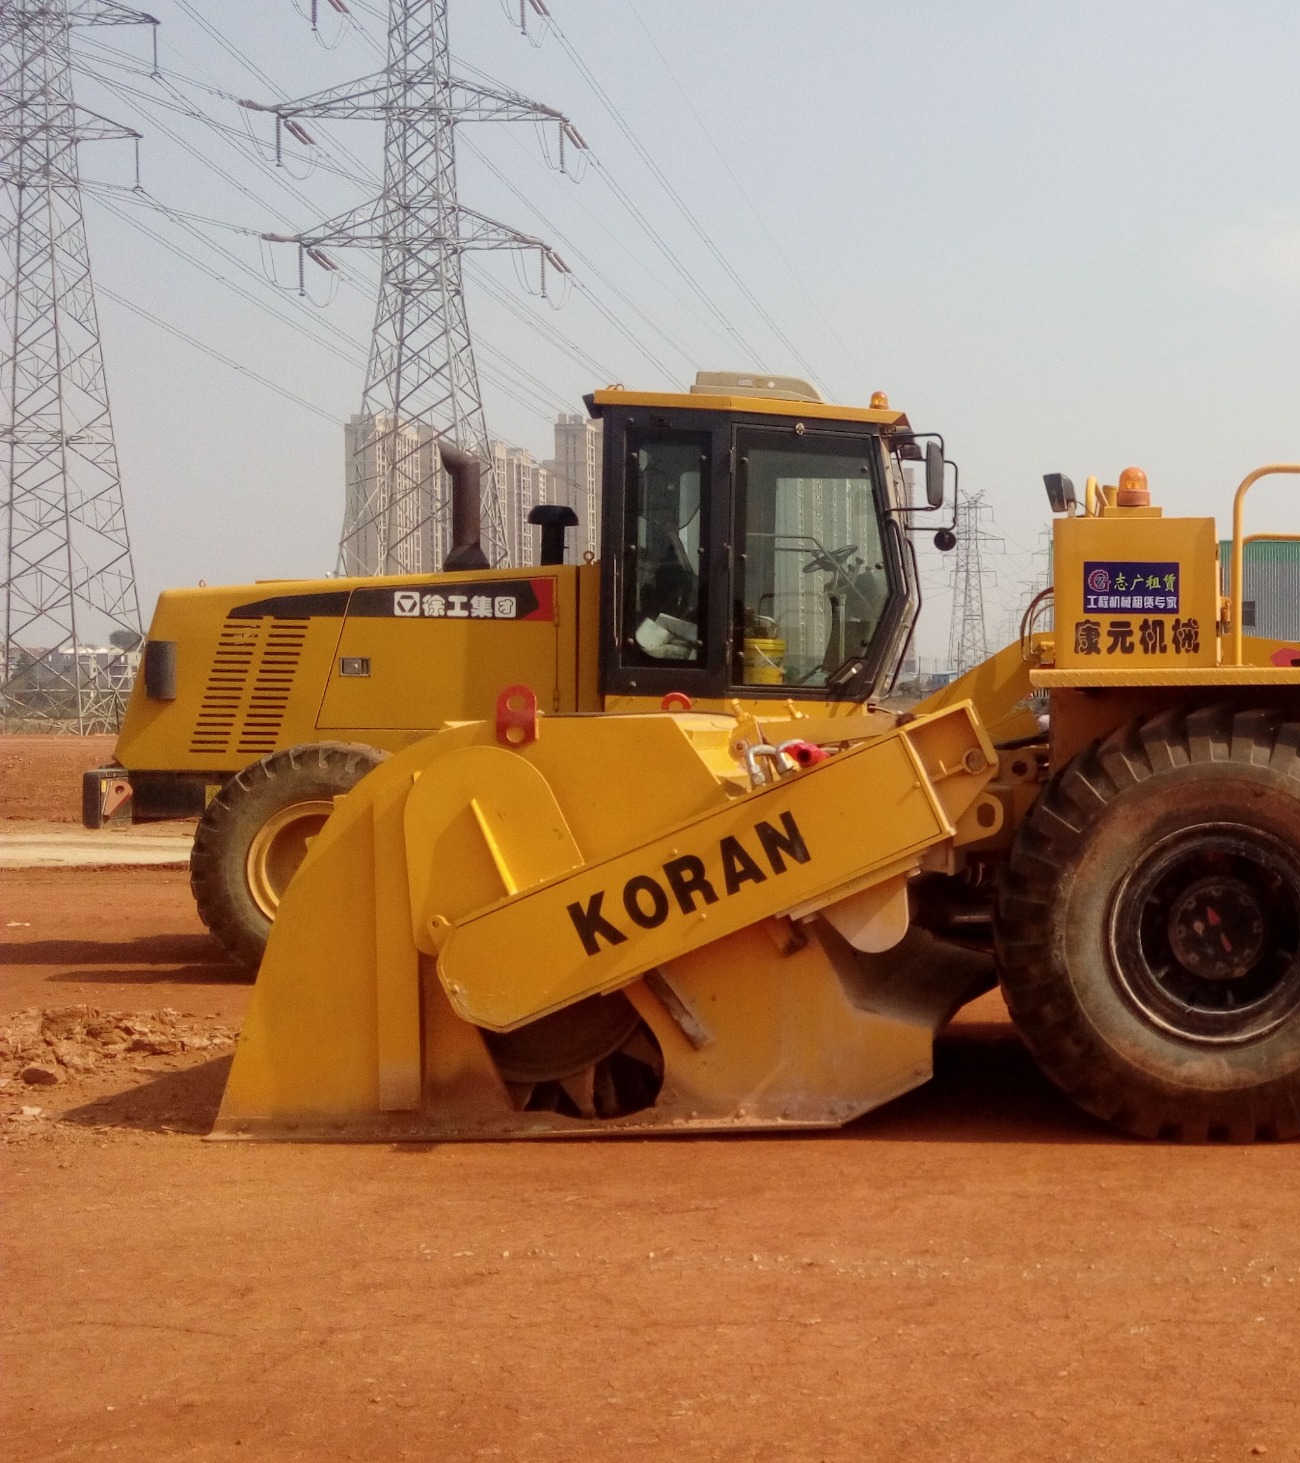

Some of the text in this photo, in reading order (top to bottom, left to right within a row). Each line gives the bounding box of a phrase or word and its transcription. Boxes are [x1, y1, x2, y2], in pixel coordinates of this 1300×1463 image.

[1114, 572, 1176, 592] 志广租赁
[422, 594, 517, 618] 徐工集团
[1087, 595, 1178, 609] 工程机械租赁专家
[1074, 618, 1200, 655] 康元机械
[566, 810, 812, 957] KORAN
